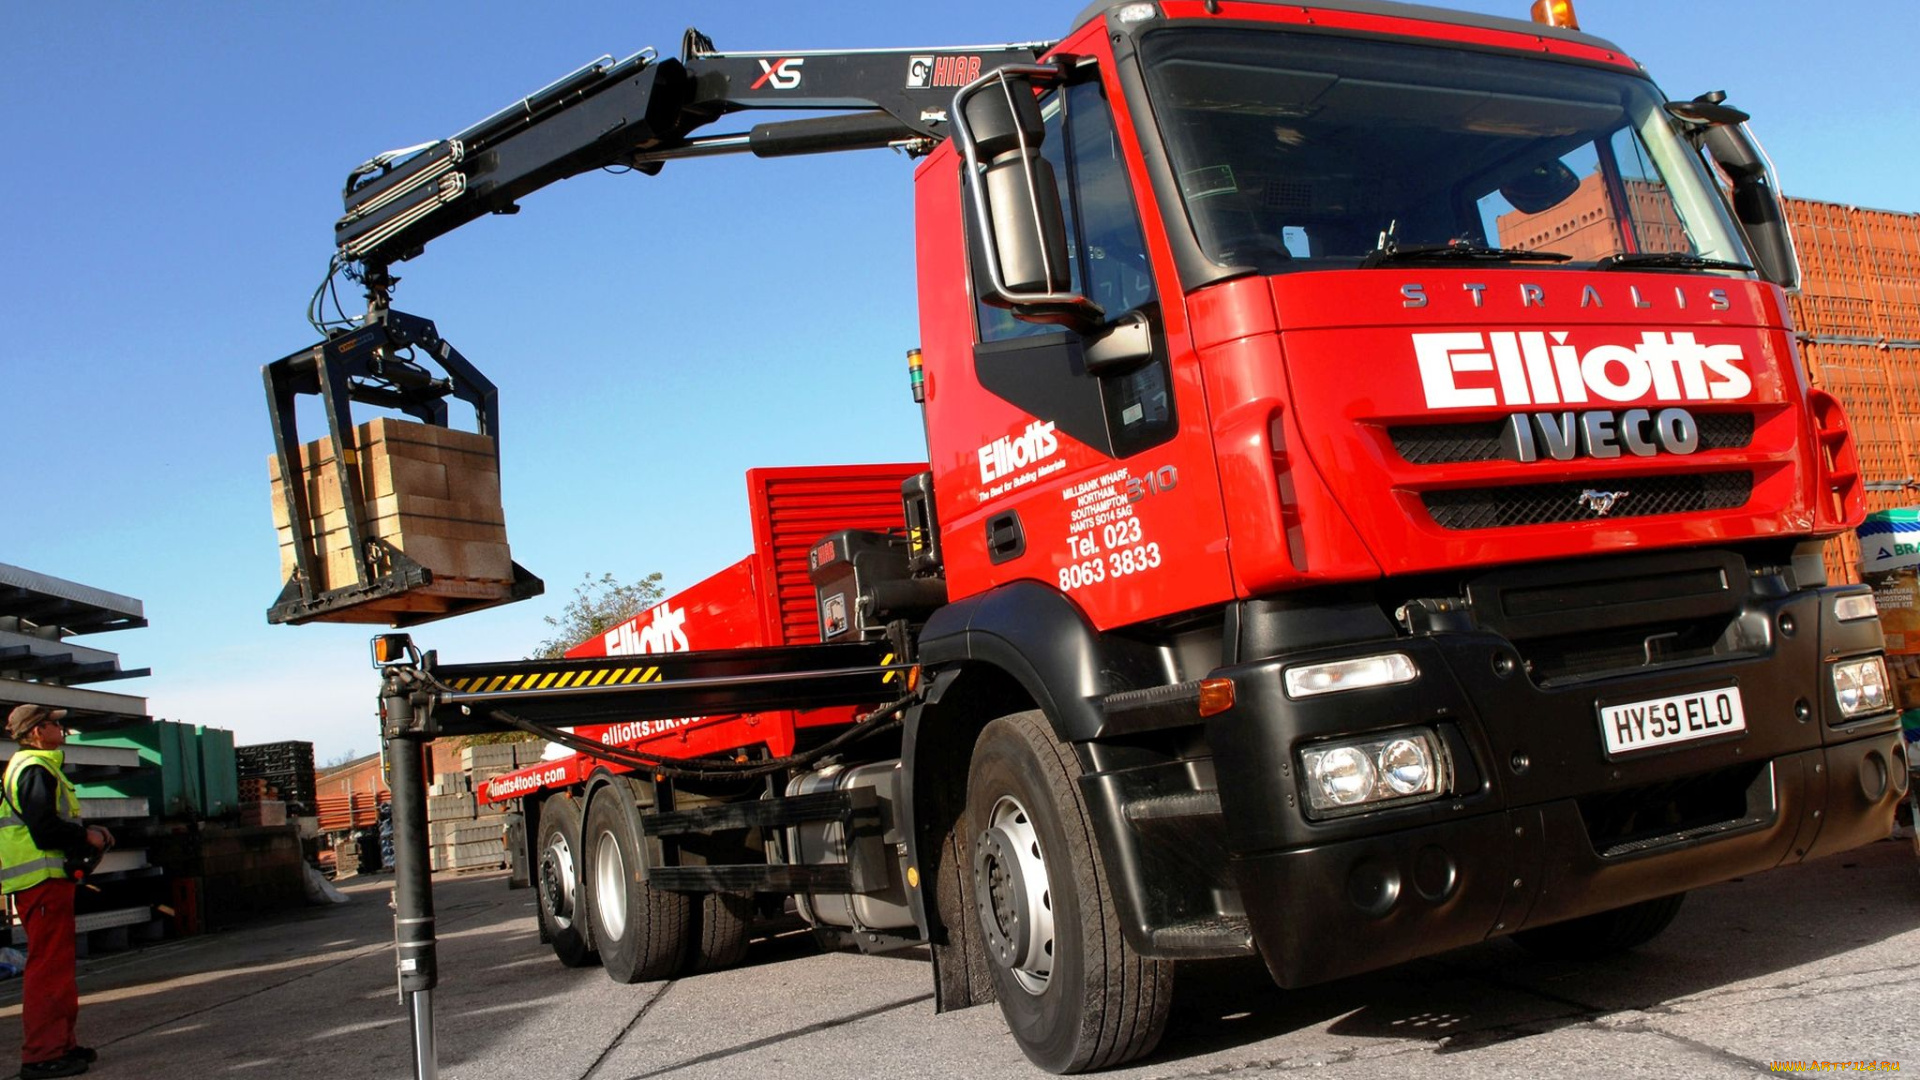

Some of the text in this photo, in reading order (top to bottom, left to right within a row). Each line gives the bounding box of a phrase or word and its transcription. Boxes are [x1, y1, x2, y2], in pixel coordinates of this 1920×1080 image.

[750, 58, 804, 89] XS
[933, 56, 981, 87] HIAB
[1401, 283, 1729, 311] STRALIS
[1411, 331, 1751, 409] Elliotts
[978, 420, 1058, 484] Elliotts
[1506, 408, 1698, 462] IVECO
[979, 458, 1066, 502] The Best for Building Materials
[1062, 467, 1131, 500] MILLBANK WHARF,
[1077, 484, 1117, 507] NORTHAM,
[1126, 465, 1177, 503] 310
[1069, 505, 1133, 534] HANTS SO14 5AG
[1071, 493, 1128, 521] SOUTHAMPTON
[1066, 517, 1143, 560] Tel. 023
[1058, 542, 1161, 591] 8063 3833
[604, 601, 690, 656] Elliotts
[602, 716, 707, 746] elliotts.uk.
[1614, 693, 1733, 744] HY59 ELO
[490, 767, 566, 797] lliotts4tools.com
